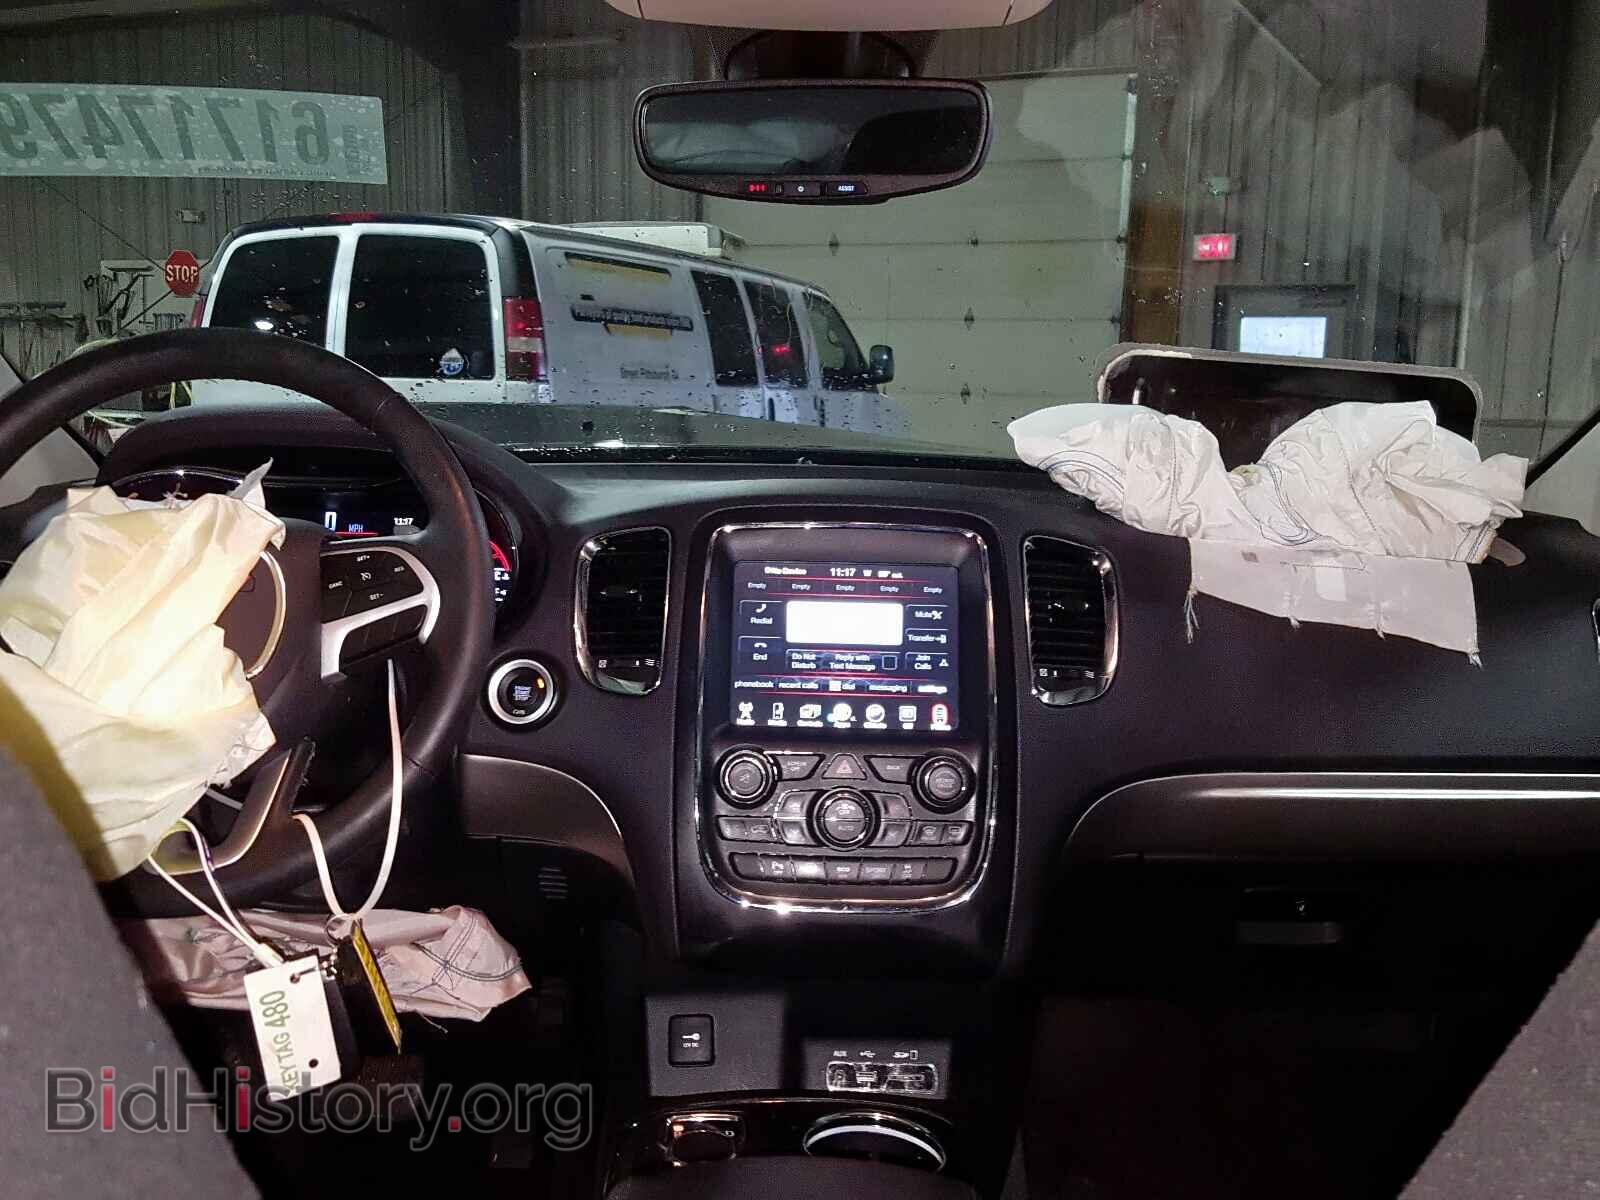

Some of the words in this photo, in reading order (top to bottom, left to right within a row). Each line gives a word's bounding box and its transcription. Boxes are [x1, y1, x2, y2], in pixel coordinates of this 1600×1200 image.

[166, 265, 198, 283] STOP
[348, 523, 364, 533] MPH
[830, 567, 856, 577] 11:17
[747, 582, 767, 590] Empty
[791, 583, 811, 591] Empty
[835, 584, 855, 592] Empty
[923, 586, 943, 594] Empty
[750, 617, 773, 625] Redial
[753, 653, 768, 661] End
[835, 654, 854, 662] Reply
[734, 680, 774, 689] phonebook
[259, 990, 291, 1027] 480
[273, 1031, 294, 1064] TAG
[279, 1063, 300, 1095] KEY
